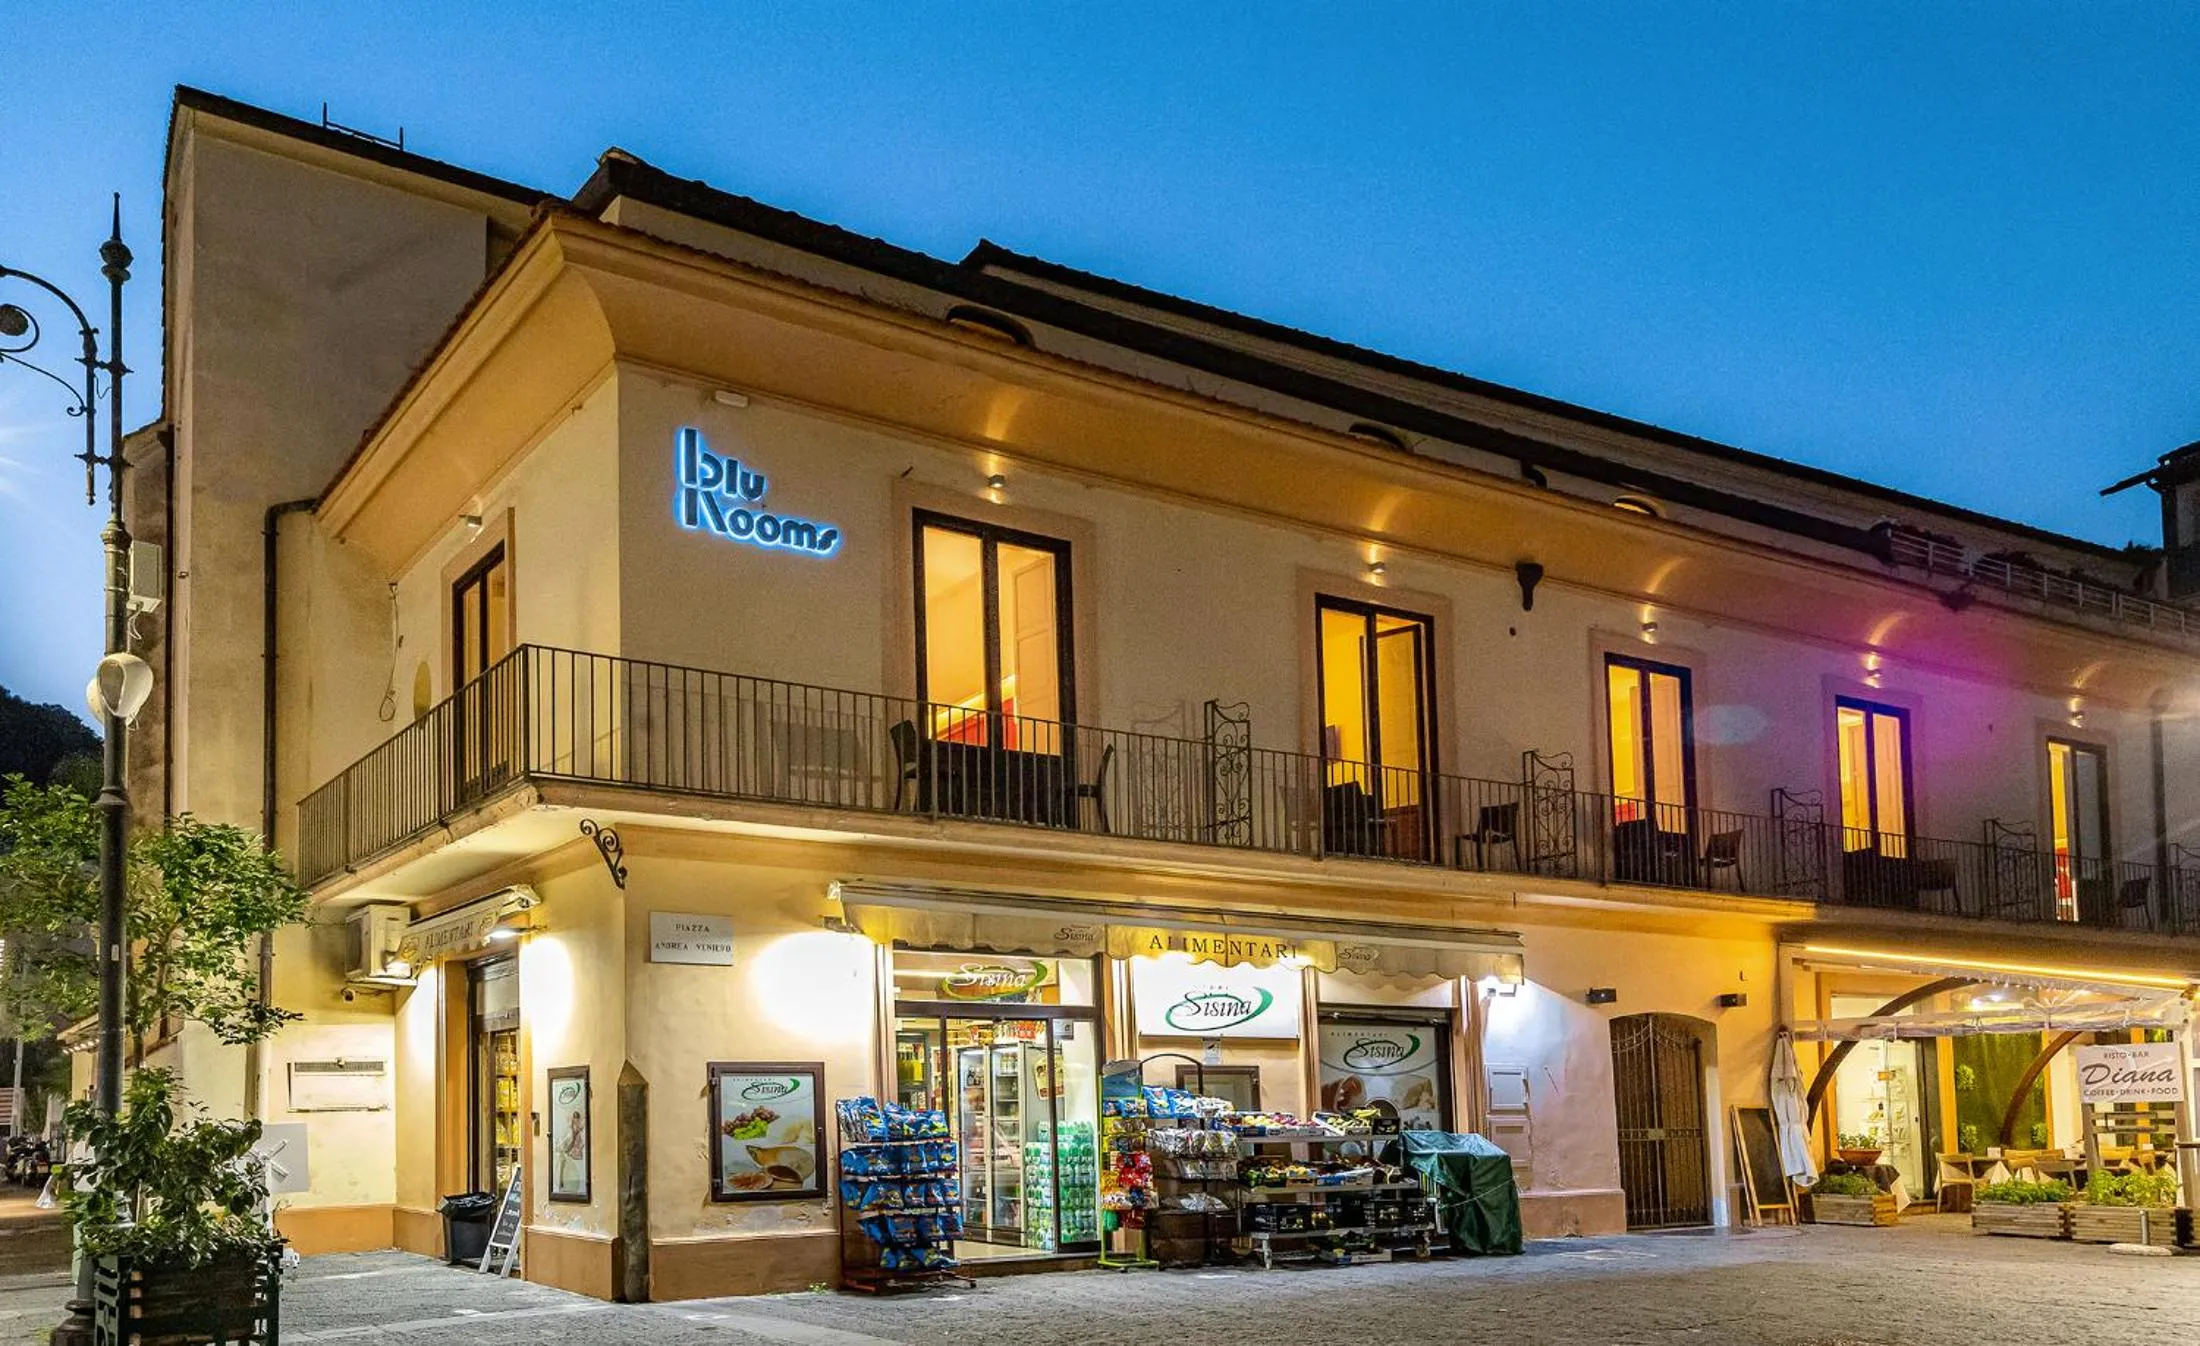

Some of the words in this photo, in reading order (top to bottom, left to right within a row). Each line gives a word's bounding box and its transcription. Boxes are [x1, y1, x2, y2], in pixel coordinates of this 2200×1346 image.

[675, 923, 710, 933] PIAZZA
[1149, 934, 1297, 959] ALIMENTARI
[1175, 990, 1252, 1017] Sisina
[1348, 1038, 1405, 1058] Sisina
[2081, 1063, 2177, 1085] Diana
